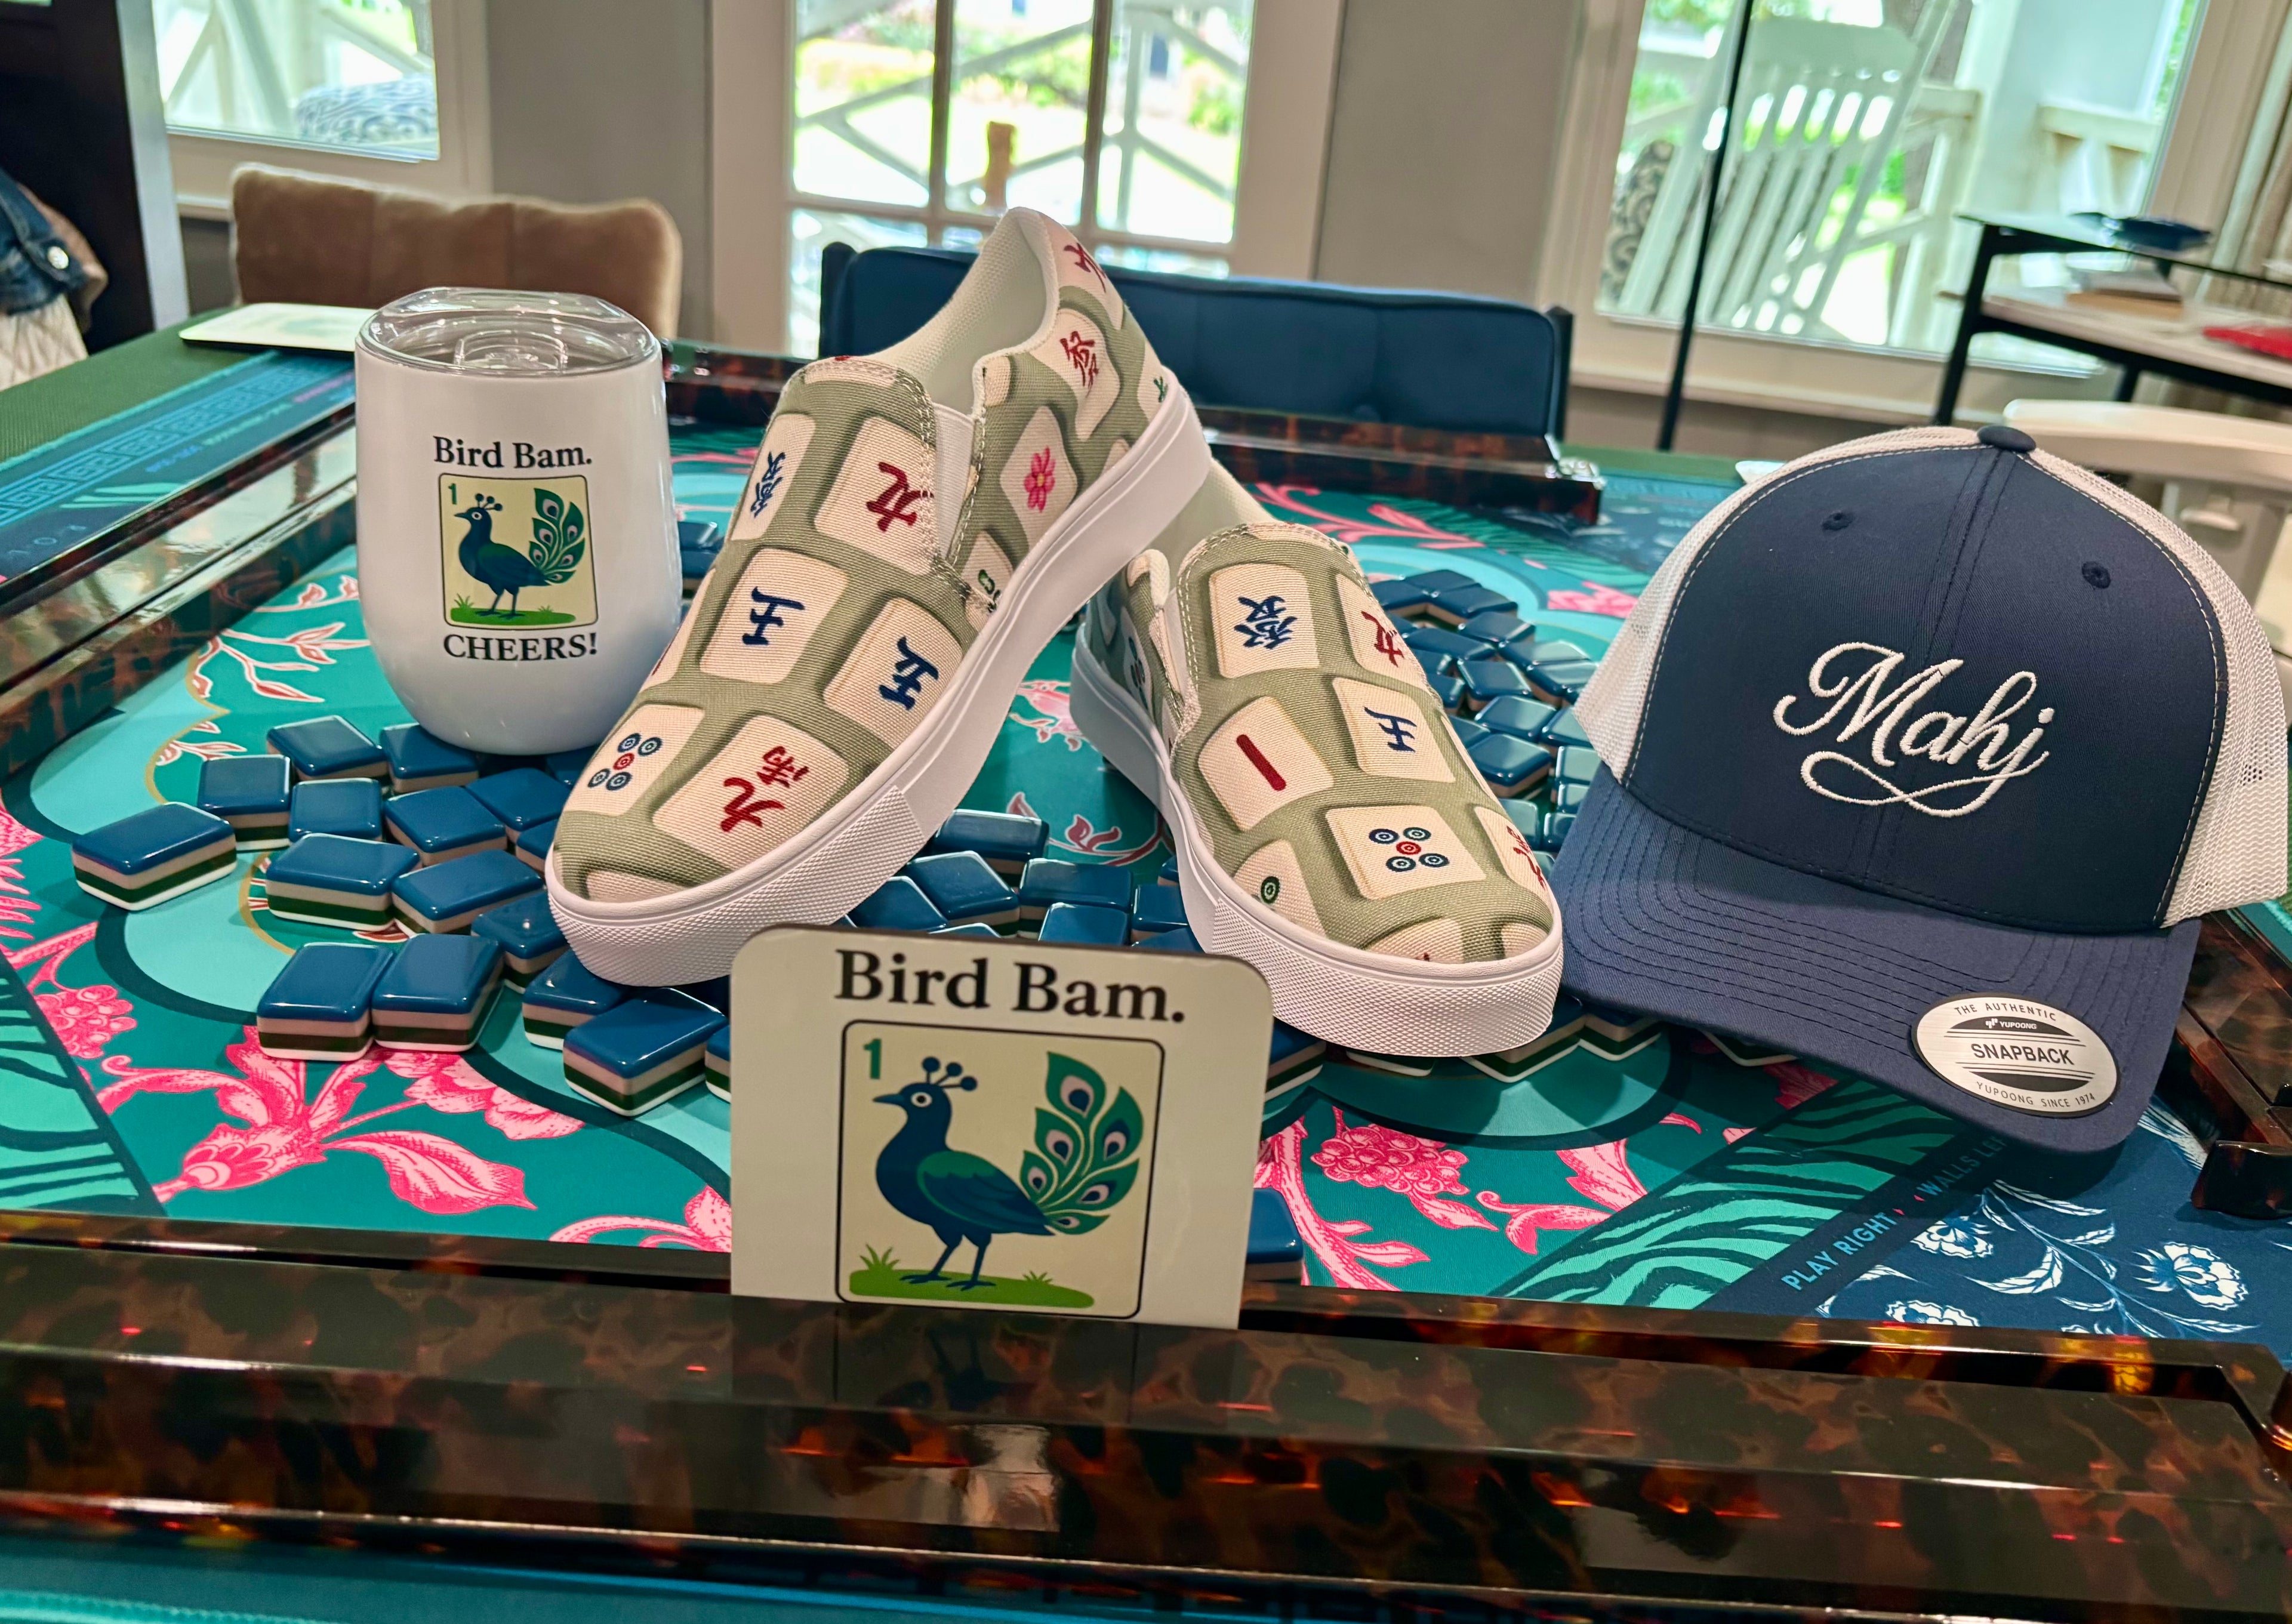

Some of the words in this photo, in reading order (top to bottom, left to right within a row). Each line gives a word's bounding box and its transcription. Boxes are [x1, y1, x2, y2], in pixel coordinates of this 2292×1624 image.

[433, 436, 504, 469] Bird
[512, 442, 593, 469] Bam.
[447, 482, 458, 506] 1
[443, 632, 599, 662] CHEERS!
[1773, 642, 2055, 818] Mahj
[834, 949, 990, 1009] Bird
[1011, 962, 1187, 1024] Bam.
[1954, 1004, 1976, 1016] THE
[1985, 1002, 2057, 1022] AUTHENTIC
[1999, 1021, 2037, 1030] YUPOONG
[863, 1038, 883, 1080] 1
[1971, 1043, 2075, 1065] SNAPBACK
[1976, 1081, 2034, 1106] YUPOONG
[2041, 1098, 2071, 1108] SINCE
[2075, 1092, 2096, 1105] 1974
[1781, 1250, 1838, 1290] PLAY
[1832, 1212, 1897, 1255] RIGHT
[1916, 1155, 1981, 1196] WALLS
